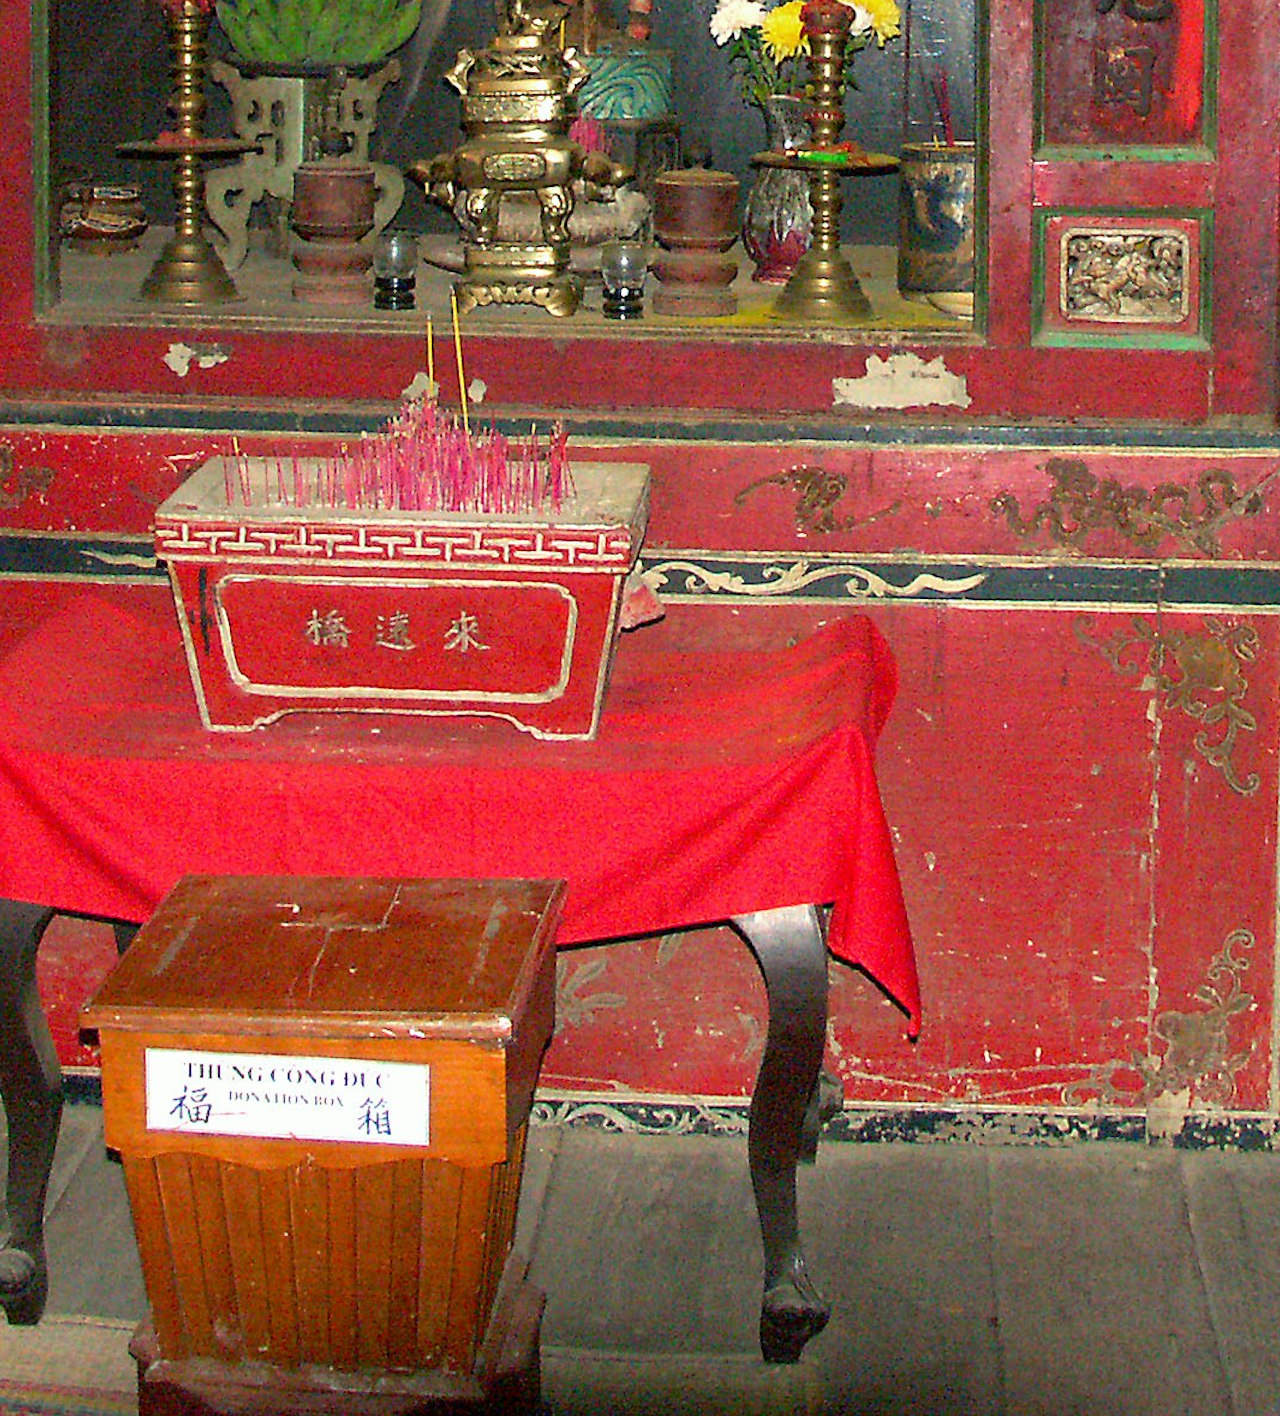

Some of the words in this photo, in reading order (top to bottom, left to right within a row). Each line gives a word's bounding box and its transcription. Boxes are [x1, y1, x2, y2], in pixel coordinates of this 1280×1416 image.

[169, 1085, 212, 1125] 福
[357, 1096, 393, 1136] 箱
[228, 1090, 310, 1106] DONATION
[313, 1094, 346, 1108] BOX
